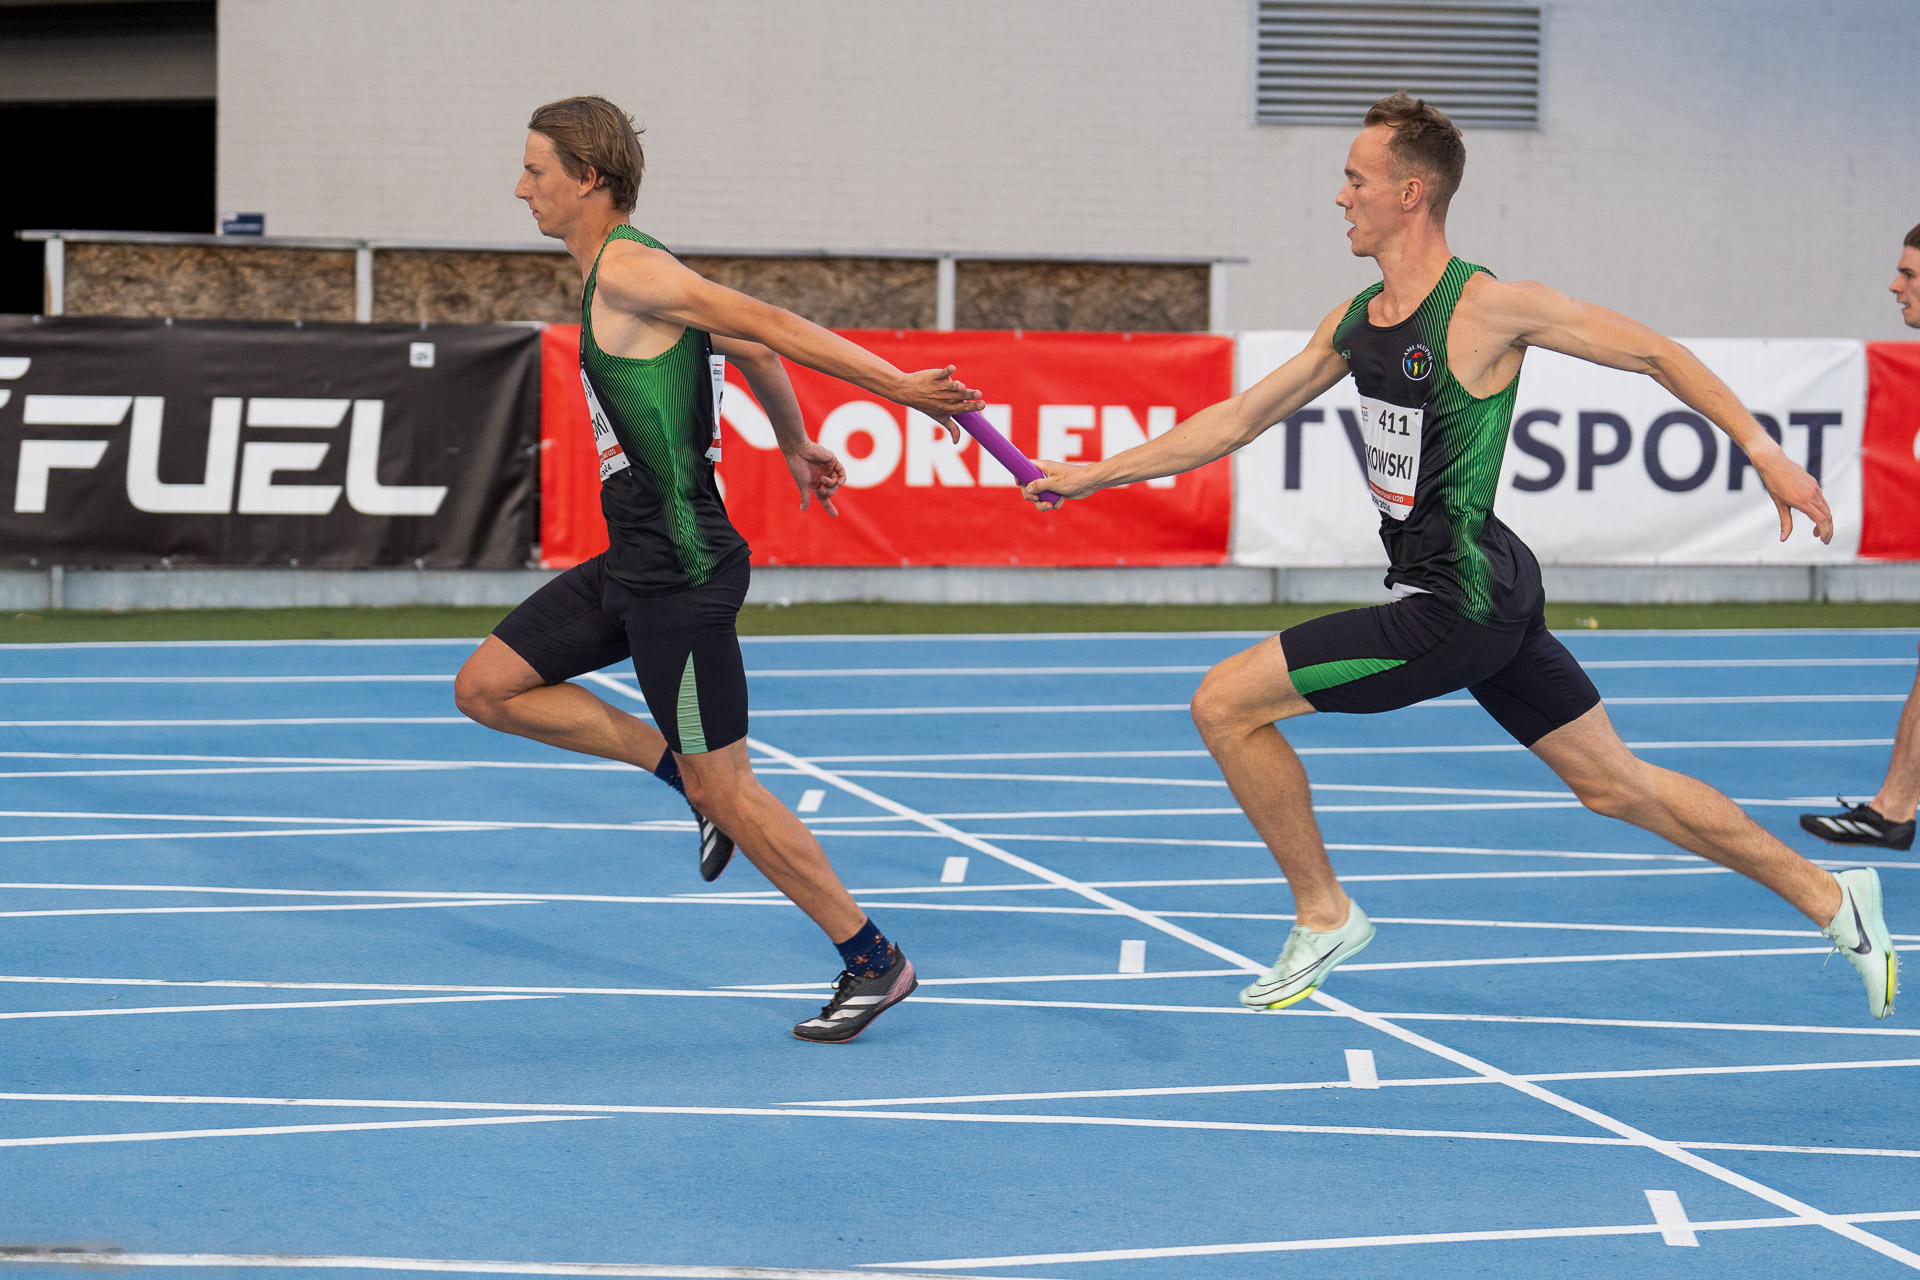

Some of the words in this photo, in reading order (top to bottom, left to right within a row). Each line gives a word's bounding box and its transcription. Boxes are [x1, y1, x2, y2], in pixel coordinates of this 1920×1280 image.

[818, 400, 1177, 488] ORLEN
[1378, 409, 1410, 437] 411
[1511, 408, 1843, 492] SPORT
[14, 394, 449, 516] FUEL
[1365, 443, 1413, 481] KOWSKI
[1392, 494, 1404, 503] U20
